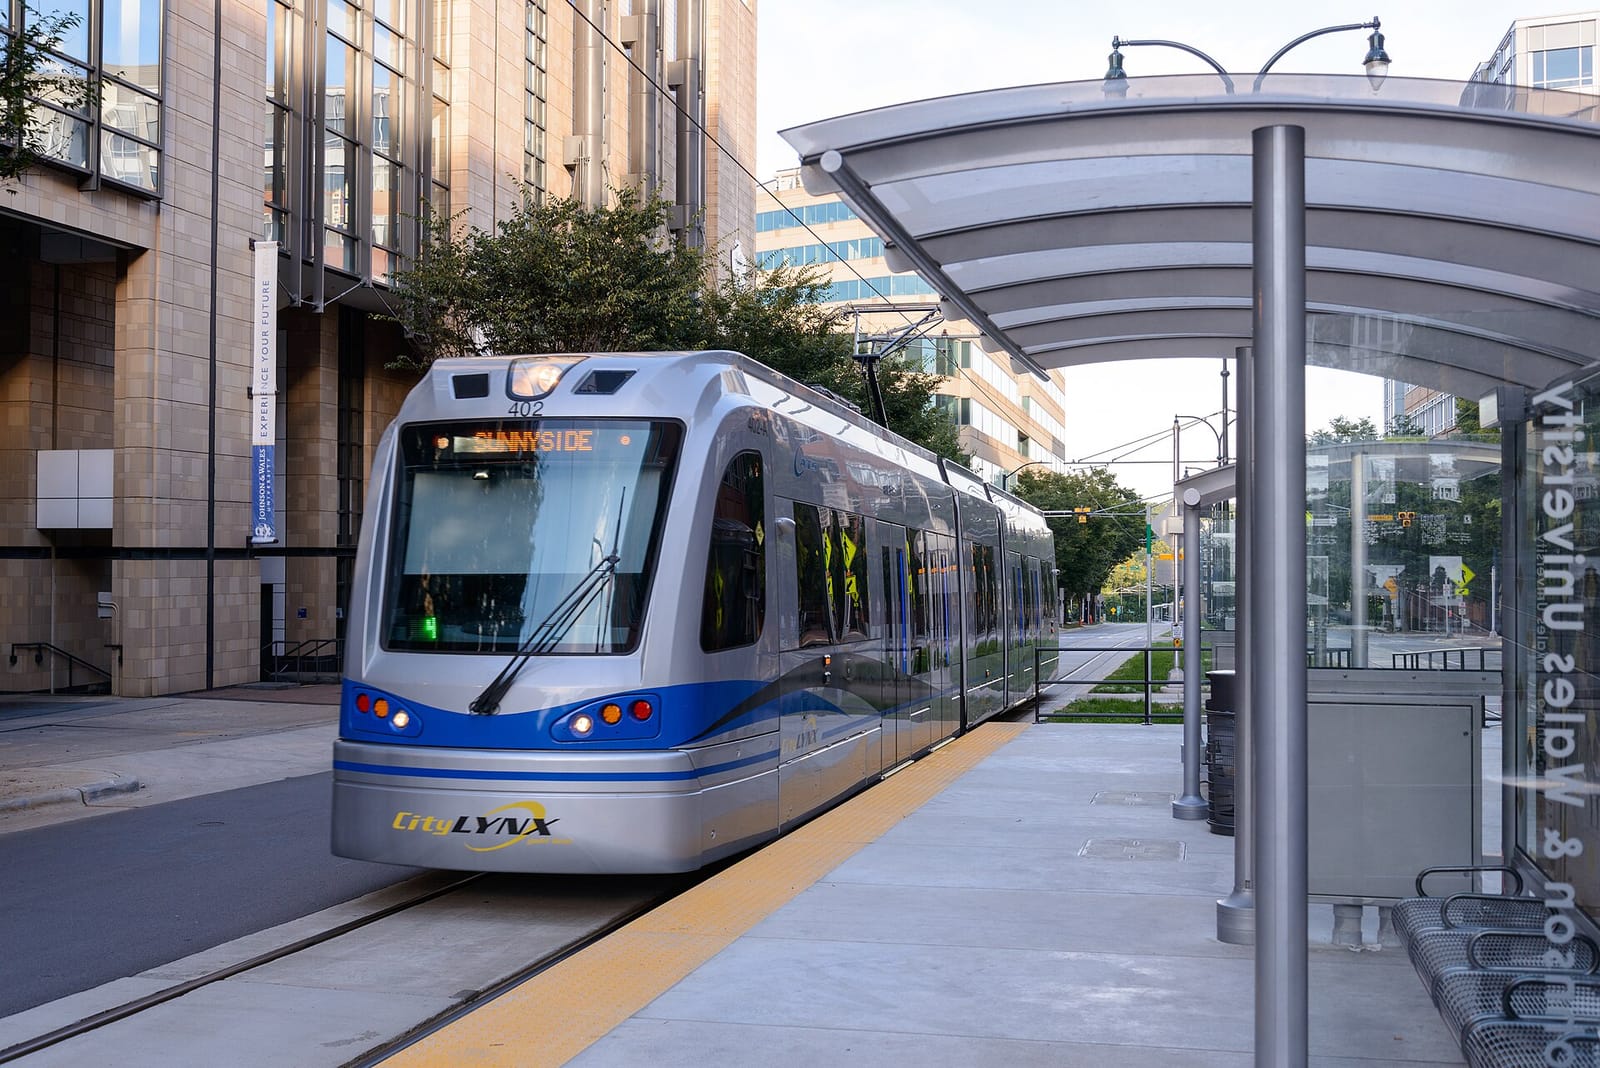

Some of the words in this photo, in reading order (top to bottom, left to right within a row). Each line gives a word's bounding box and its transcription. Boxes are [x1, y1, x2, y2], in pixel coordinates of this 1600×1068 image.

[261, 280, 270, 325] FUTURE
[261, 330, 269, 362] YOUR
[260, 367, 269, 438] EXPERIENCE
[508, 401, 544, 416] 402
[474, 430, 593, 452] SUNNYSIDE
[392, 812, 560, 836] CityLYNX
